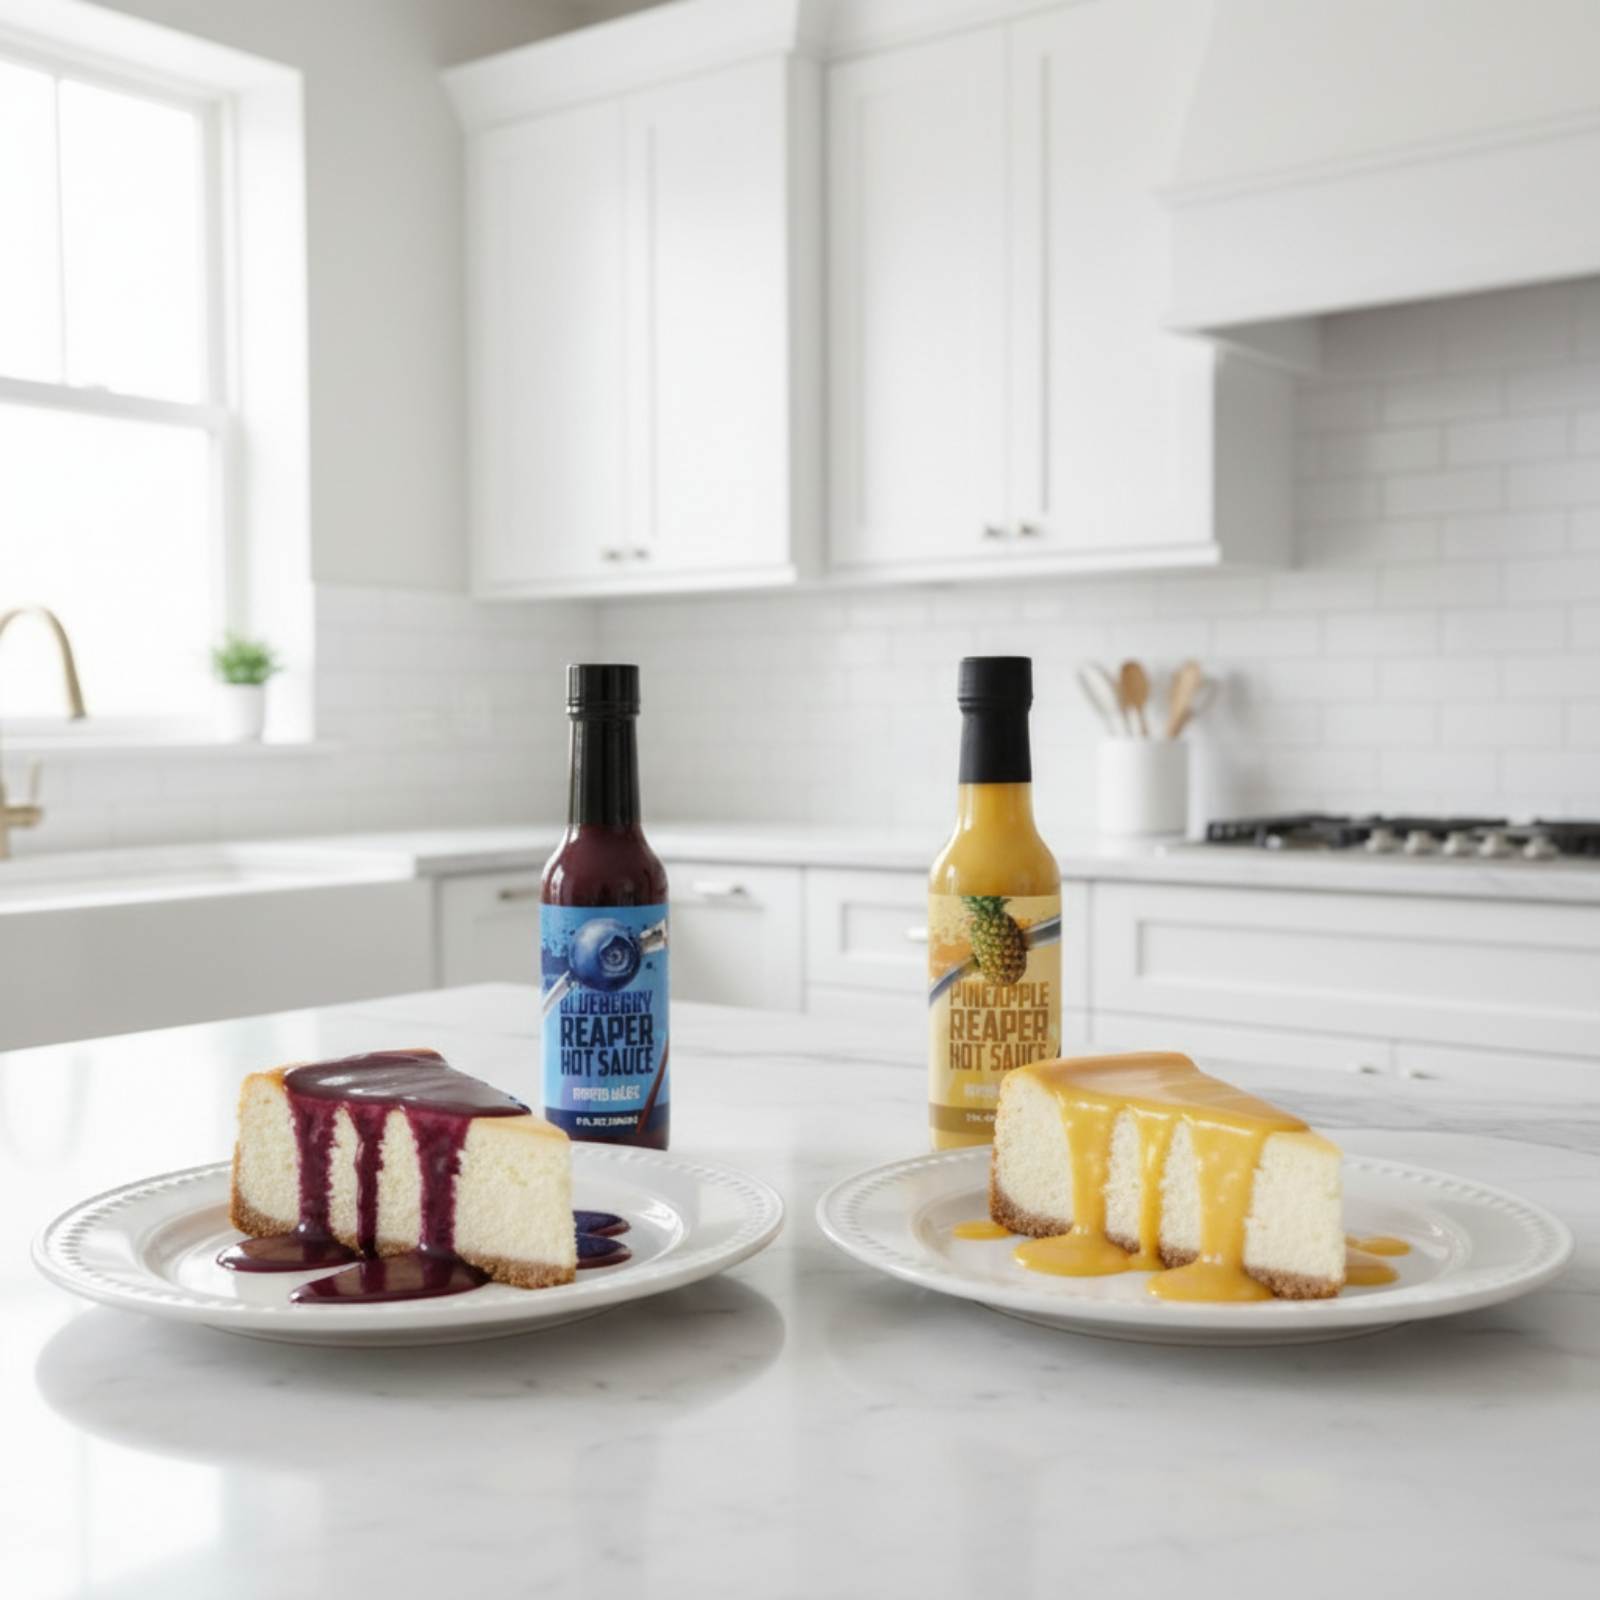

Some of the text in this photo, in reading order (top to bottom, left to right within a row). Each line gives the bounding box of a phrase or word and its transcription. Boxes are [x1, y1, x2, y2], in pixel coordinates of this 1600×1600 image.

[560, 1014, 653, 1047] REAPER
[950, 1009, 1049, 1042] REAPER
[561, 1047, 653, 1077] HOT SAUCE
[950, 1042, 986, 1071] HOT
